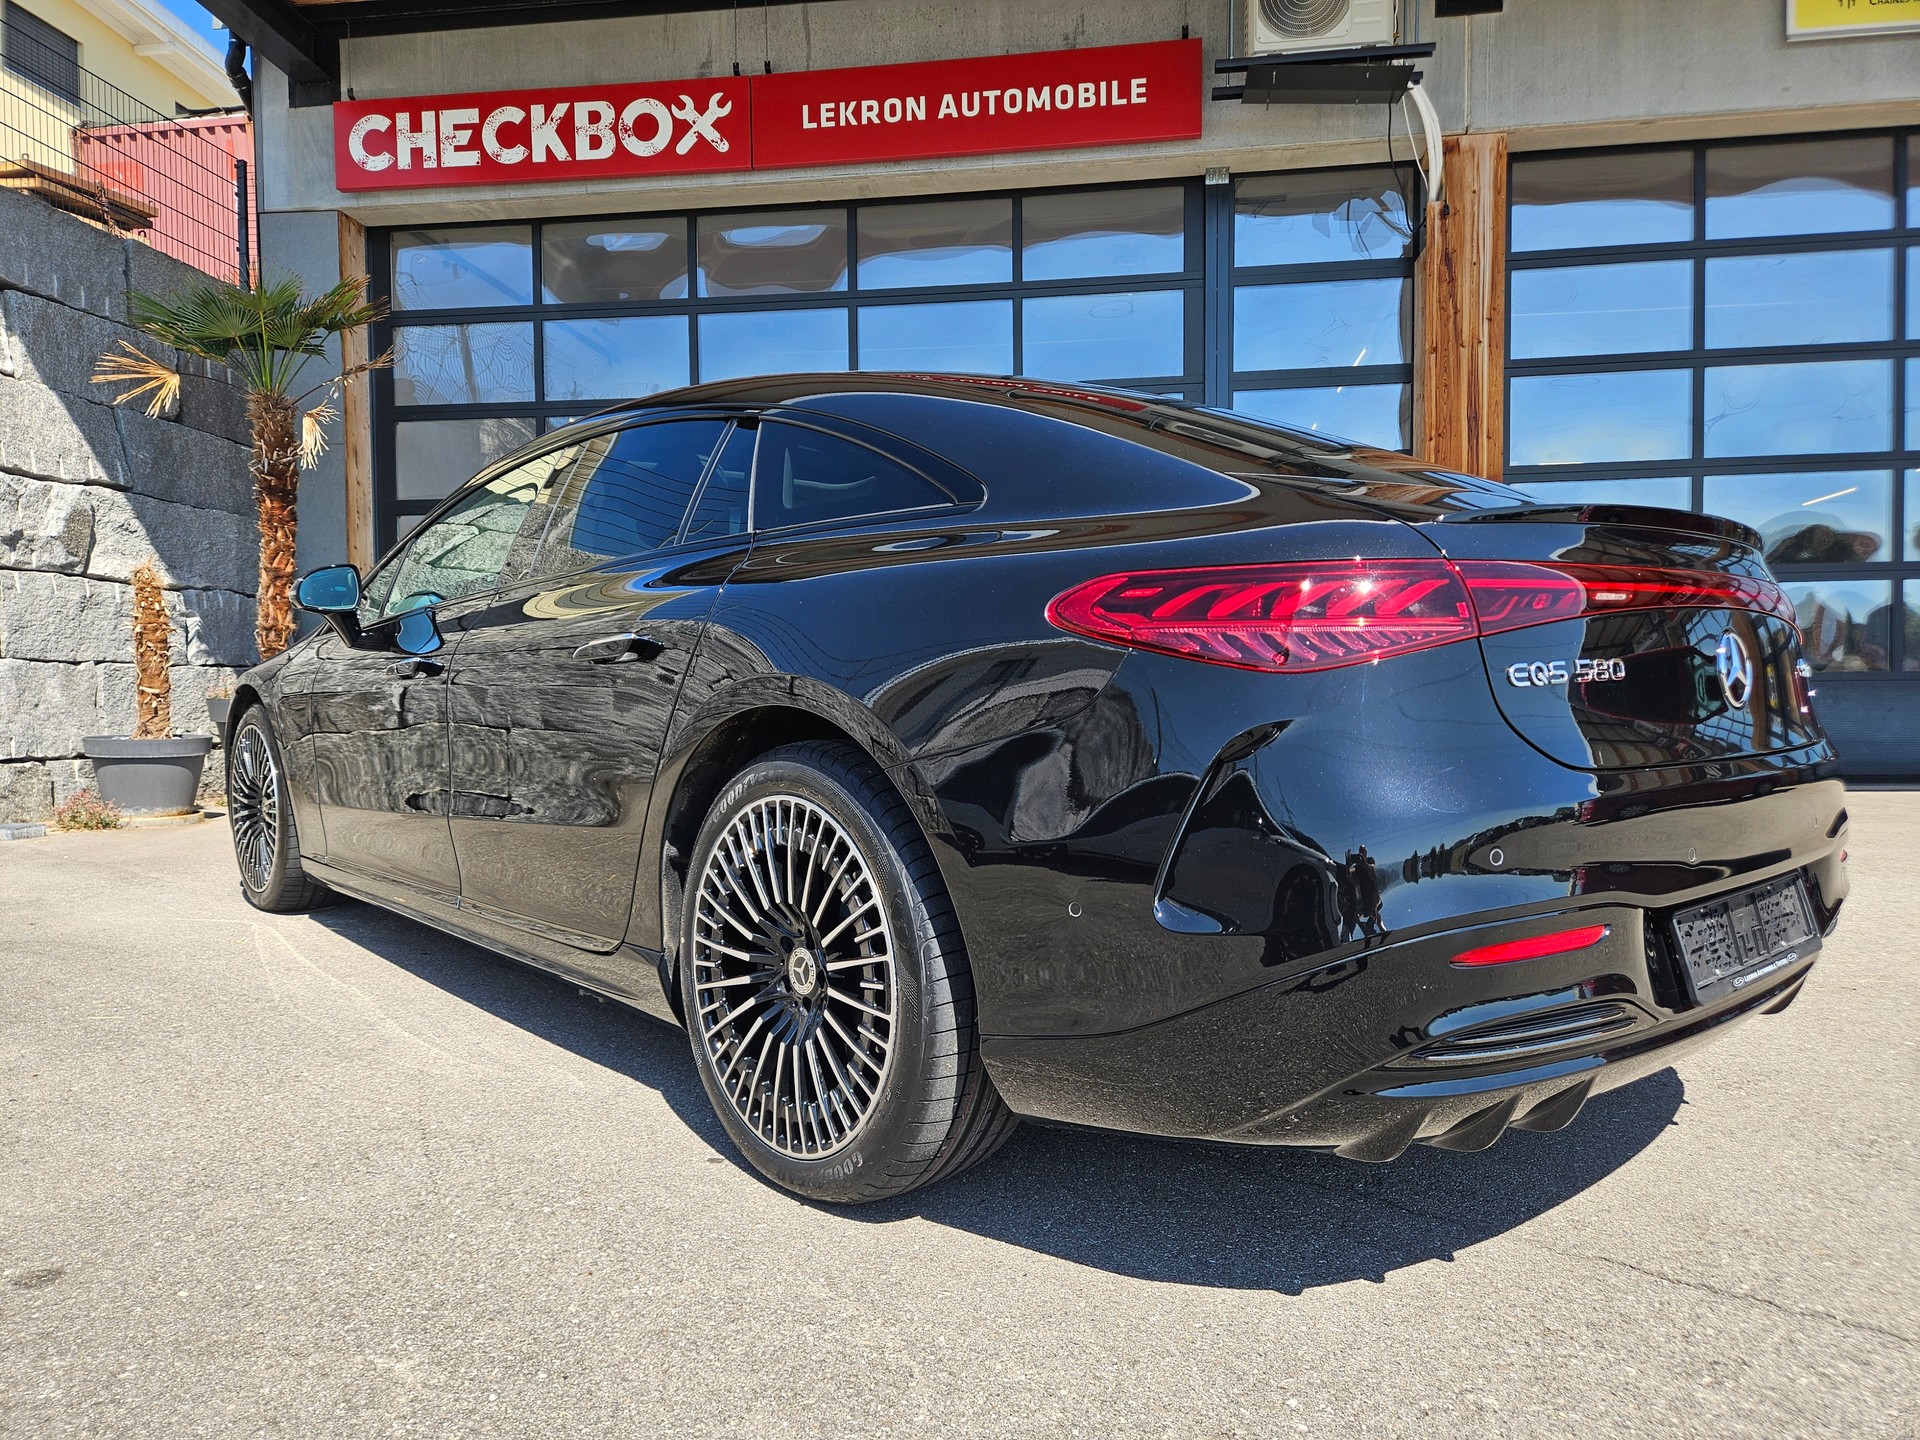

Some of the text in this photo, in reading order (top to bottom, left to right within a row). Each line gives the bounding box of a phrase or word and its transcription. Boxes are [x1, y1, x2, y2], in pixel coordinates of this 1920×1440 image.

[801, 77, 1148, 130] LEKRON AUTOMOBILE
[347, 91, 733, 172] CHECKBOX
[1507, 658, 1626, 688] EQS 580
